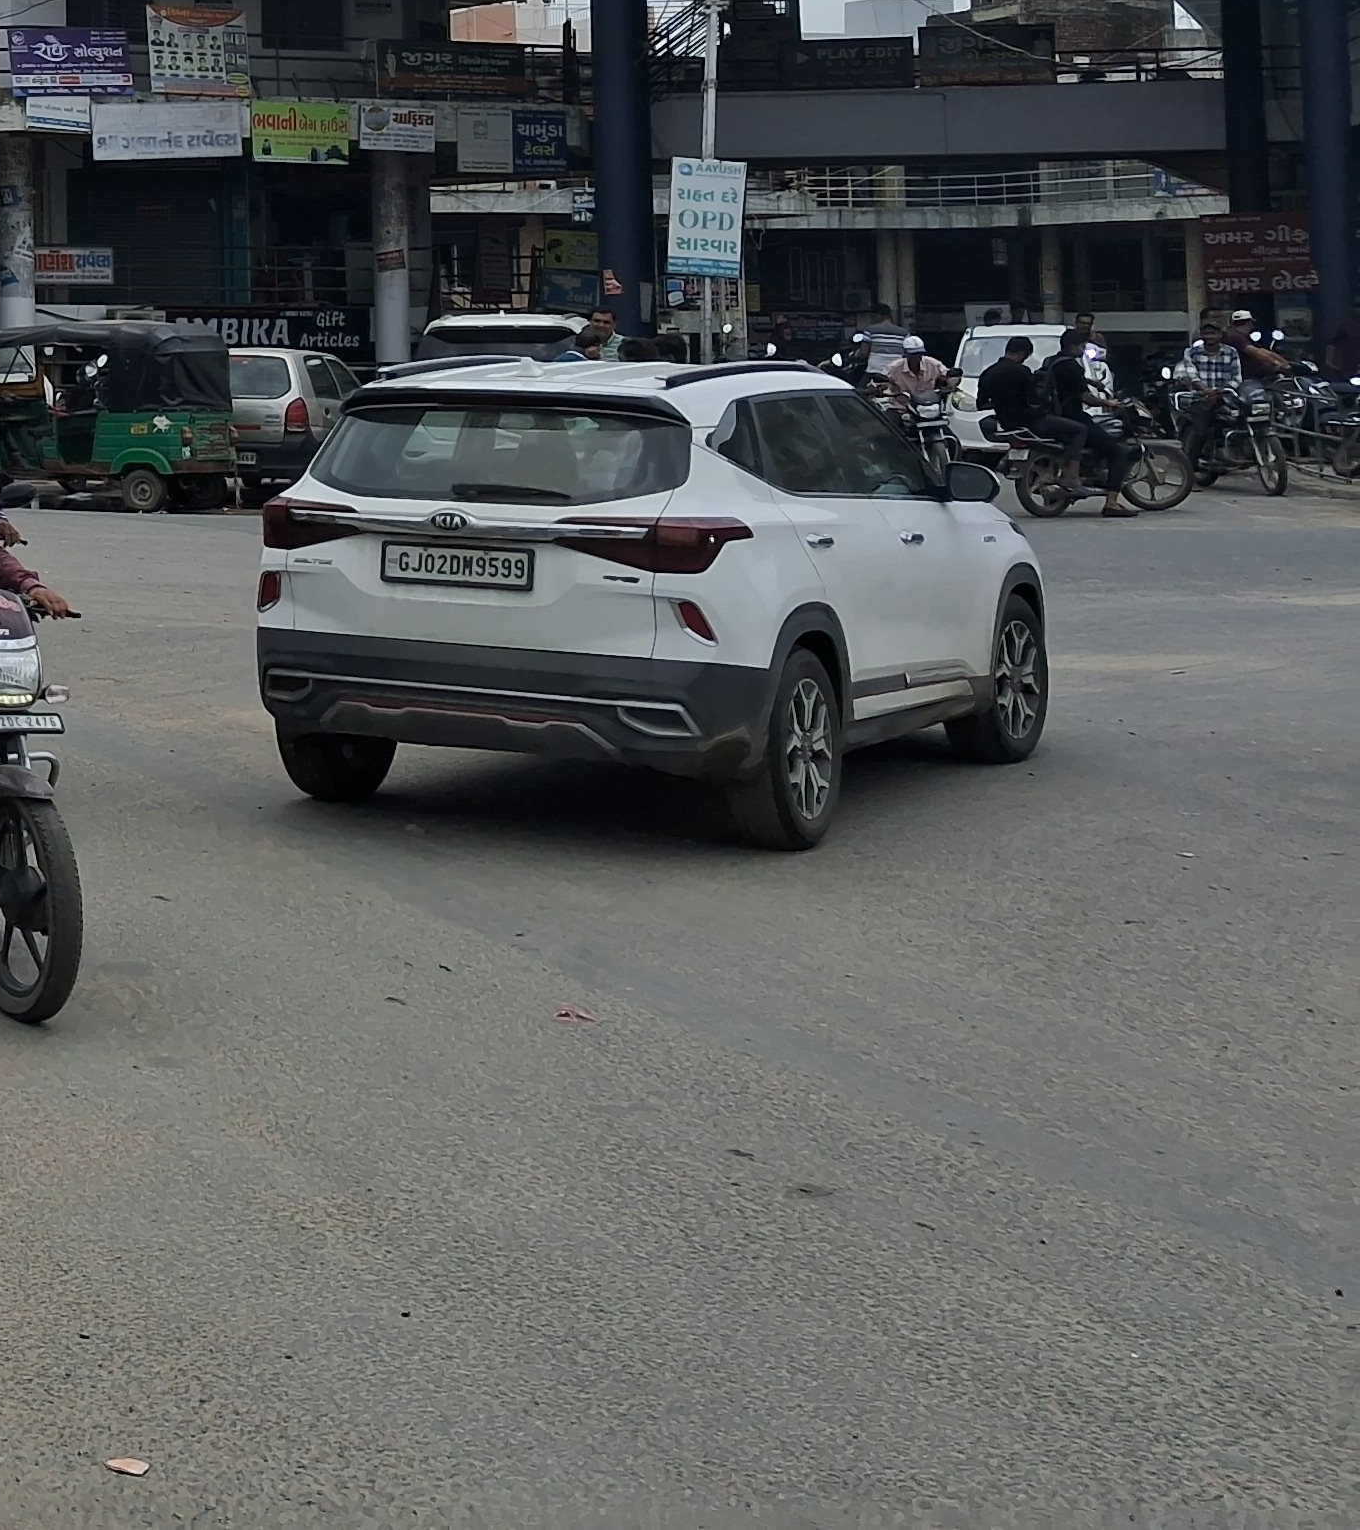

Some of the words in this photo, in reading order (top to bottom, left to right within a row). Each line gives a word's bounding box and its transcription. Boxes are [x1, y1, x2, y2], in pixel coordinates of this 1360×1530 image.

[817, 47, 859, 59] PLAY
[865, 46, 903, 58] EDIT
[695, 163, 742, 175] AAYUSH
[677, 187, 715, 203] રાહત
[678, 208, 735, 231] OPD
[675, 236, 738, 255] સારવાર
[316, 311, 346, 327] Gift
[299, 333, 360, 348] Articles
[434, 513, 463, 529] KIA
[398, 551, 525, 580] GJ02DM9599
